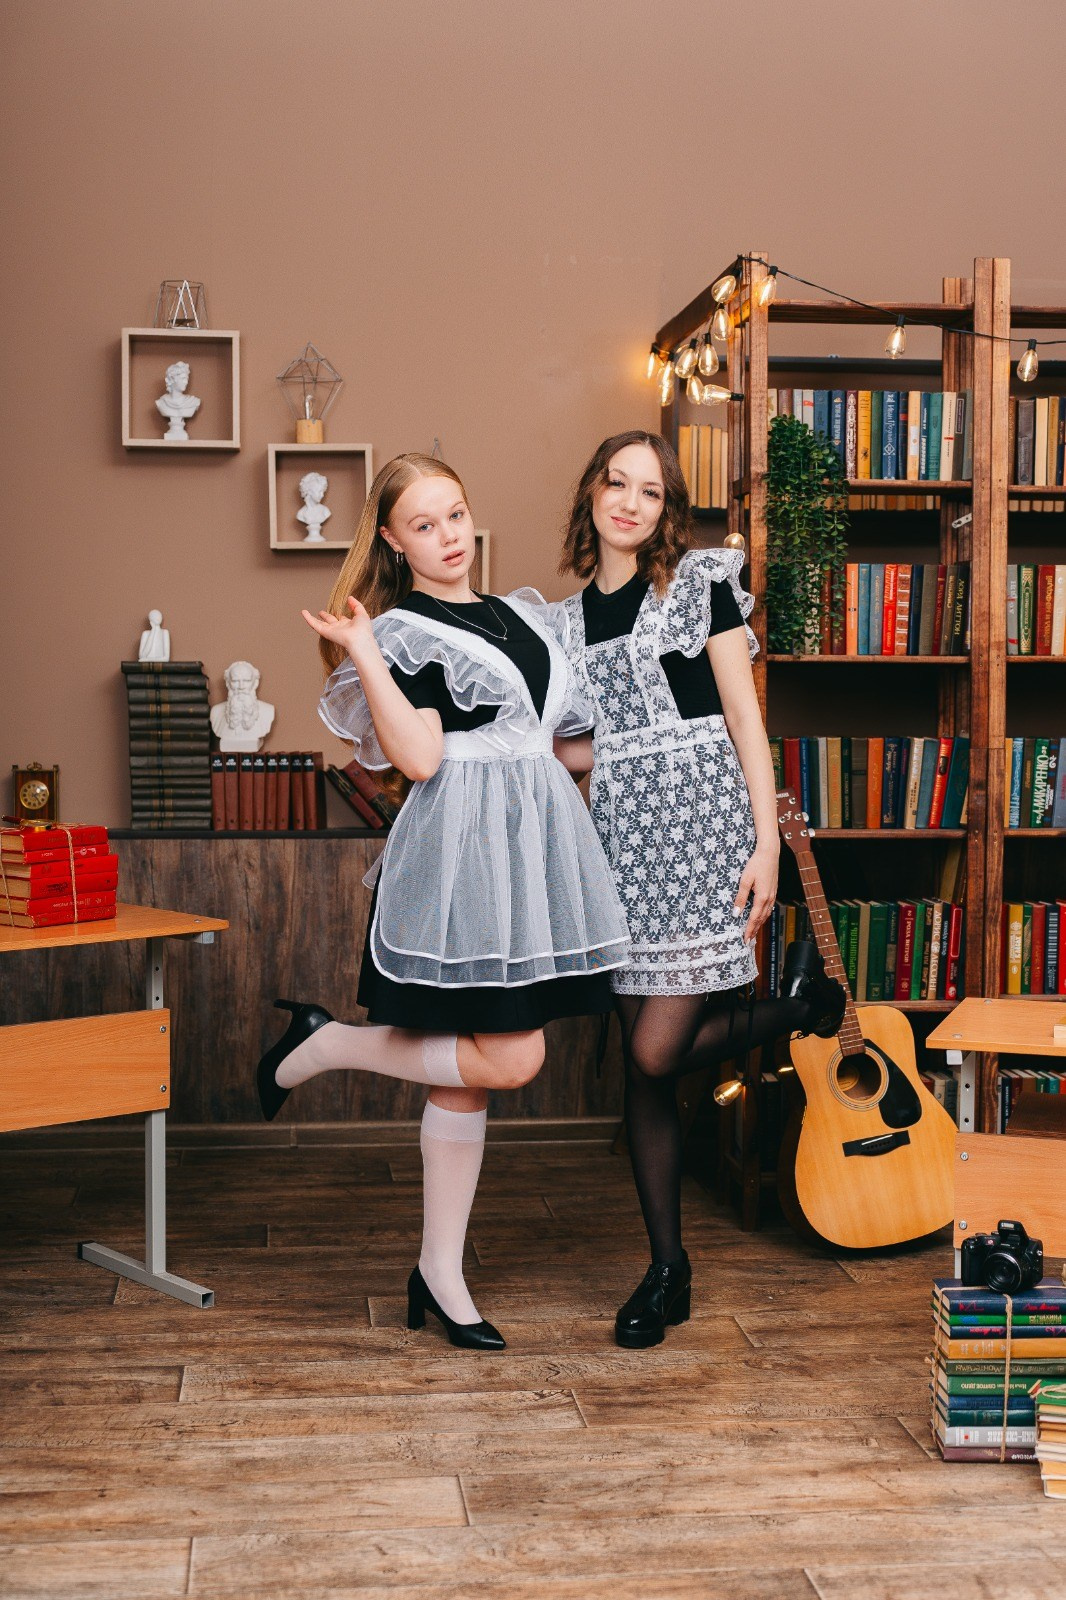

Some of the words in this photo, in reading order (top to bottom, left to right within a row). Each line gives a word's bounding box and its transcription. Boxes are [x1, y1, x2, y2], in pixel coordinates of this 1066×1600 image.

[933, 910, 942, 940] ДОРИС
[930, 953, 939, 992] ЛЕССИНГ
[960, 1381, 976, 1390] ДЕЛО
